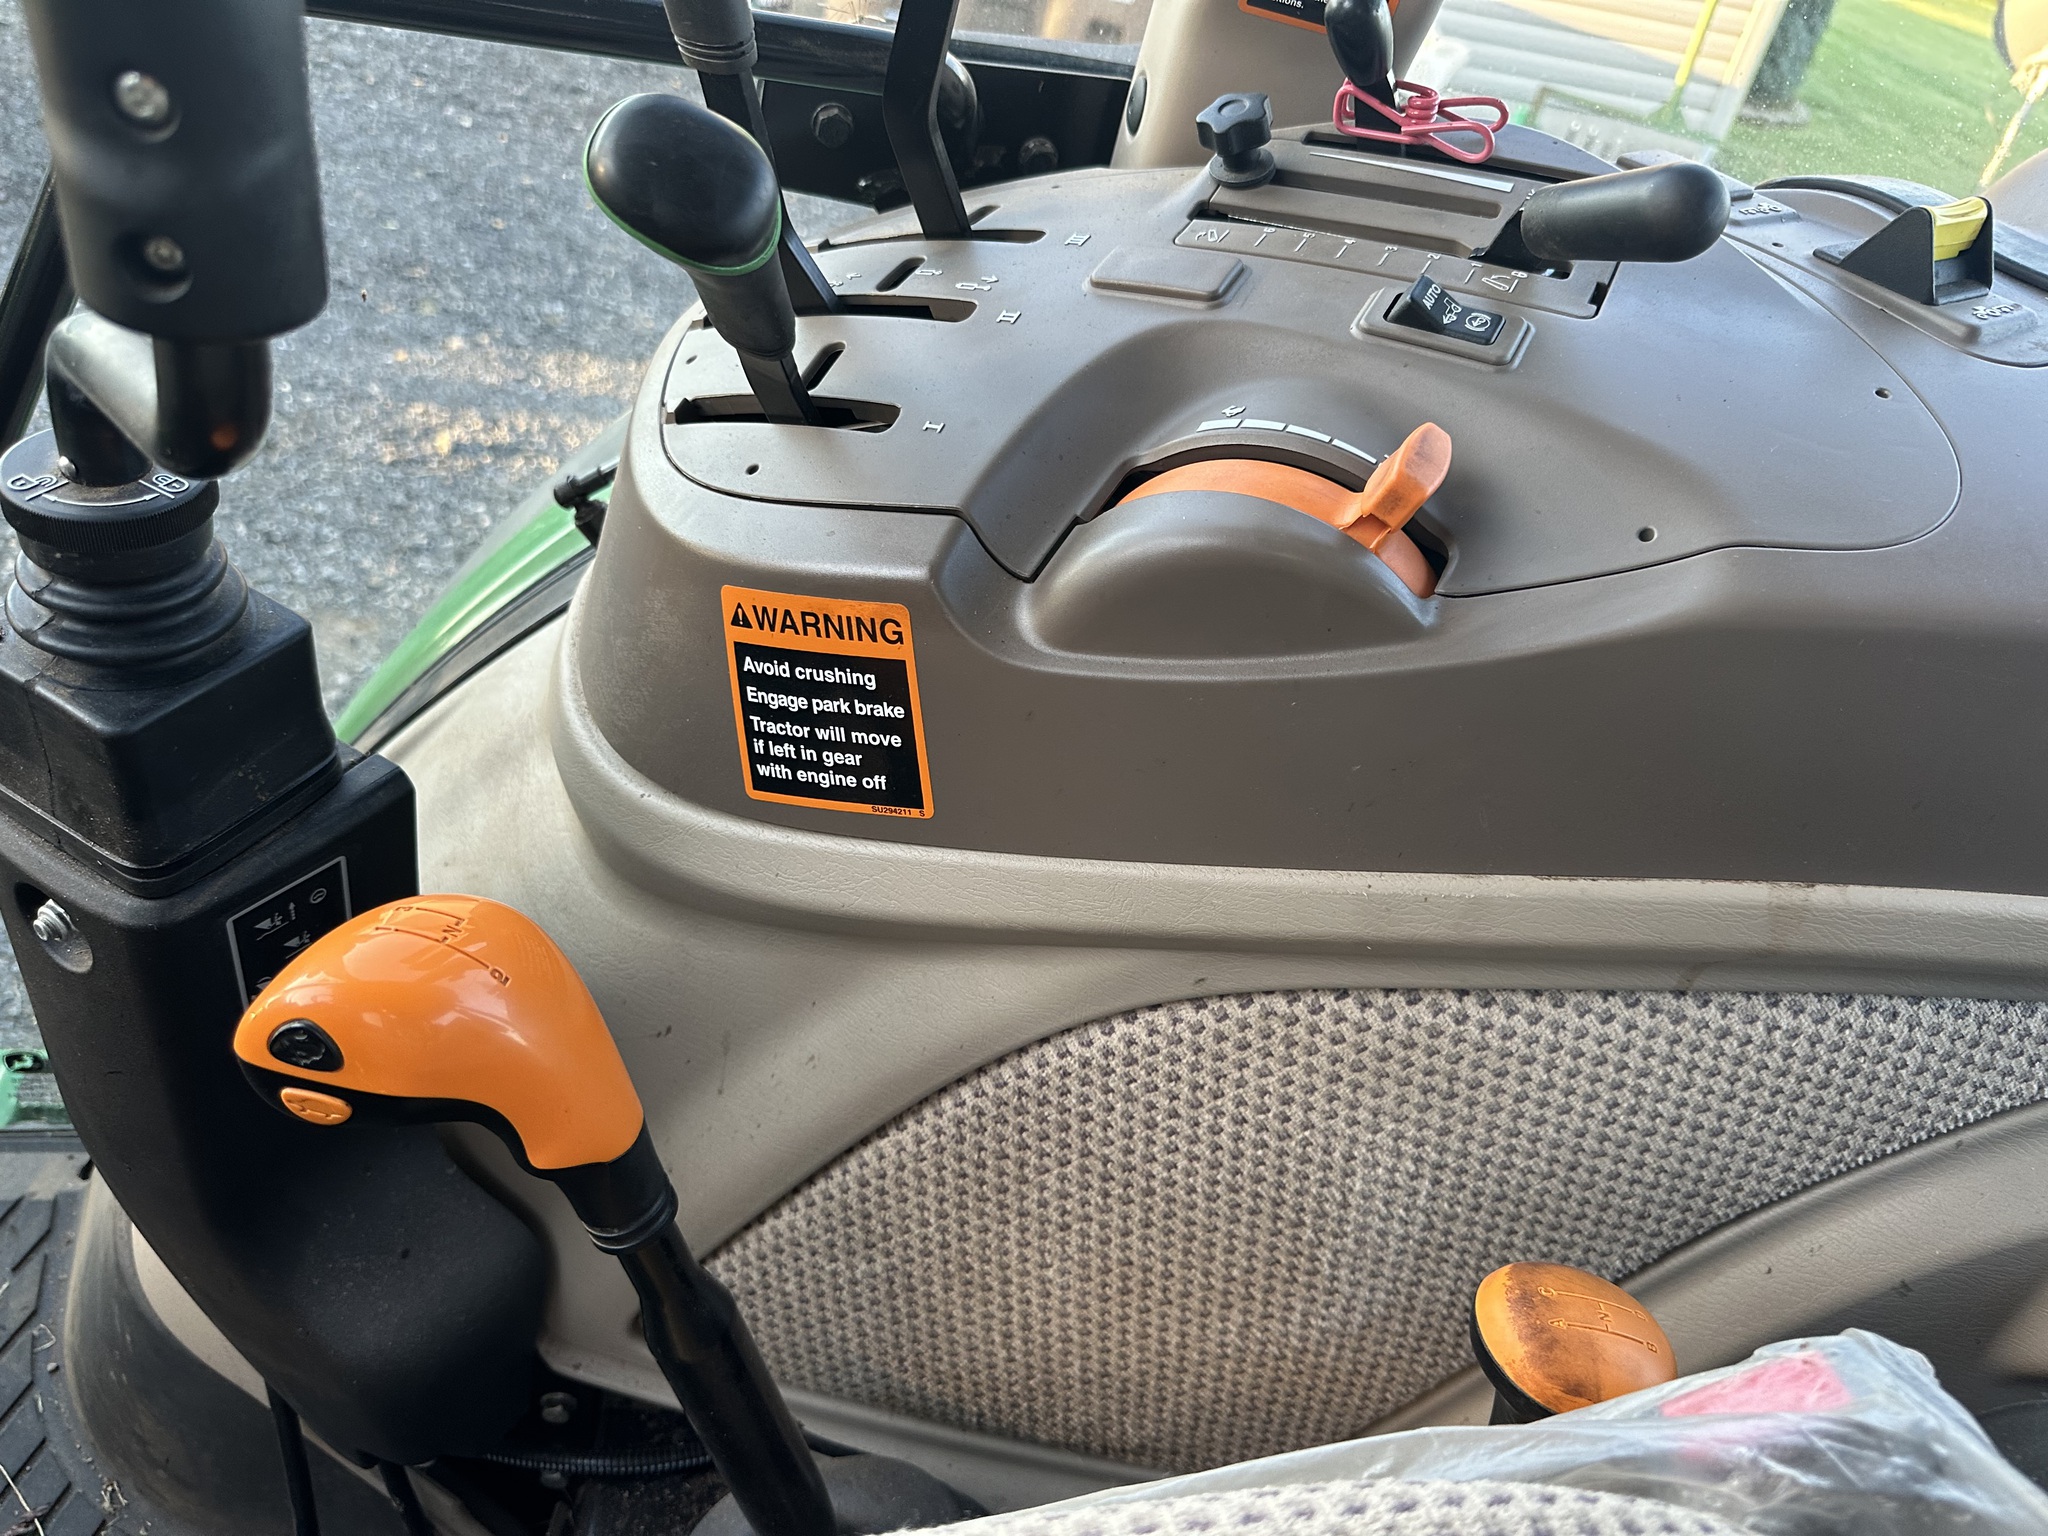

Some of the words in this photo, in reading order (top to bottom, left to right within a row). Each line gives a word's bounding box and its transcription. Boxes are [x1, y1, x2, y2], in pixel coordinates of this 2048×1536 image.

[1422, 283, 1442, 310] AUTO
[752, 605, 904, 645] WARNING
[743, 656, 790, 678] Avoid
[796, 665, 876, 690] crushing
[746, 686, 808, 712] Engage
[812, 698, 851, 714] park
[855, 700, 905, 718] brake
[750, 716, 810, 738] Tractor
[815, 726, 846, 742] will
[851, 731, 902, 747] move
[753, 738, 764, 754] if
[769, 742, 797, 759] left
[801, 746, 817, 761] in
[823, 751, 862, 767] gear
[757, 764, 792, 780] with
[797, 771, 857, 788] engine
[862, 775, 886, 790] off
[871, 806, 912, 816] SU294211
[1548, 1317, 1567, 1330] A
[1646, 1341, 1658, 1354] B
